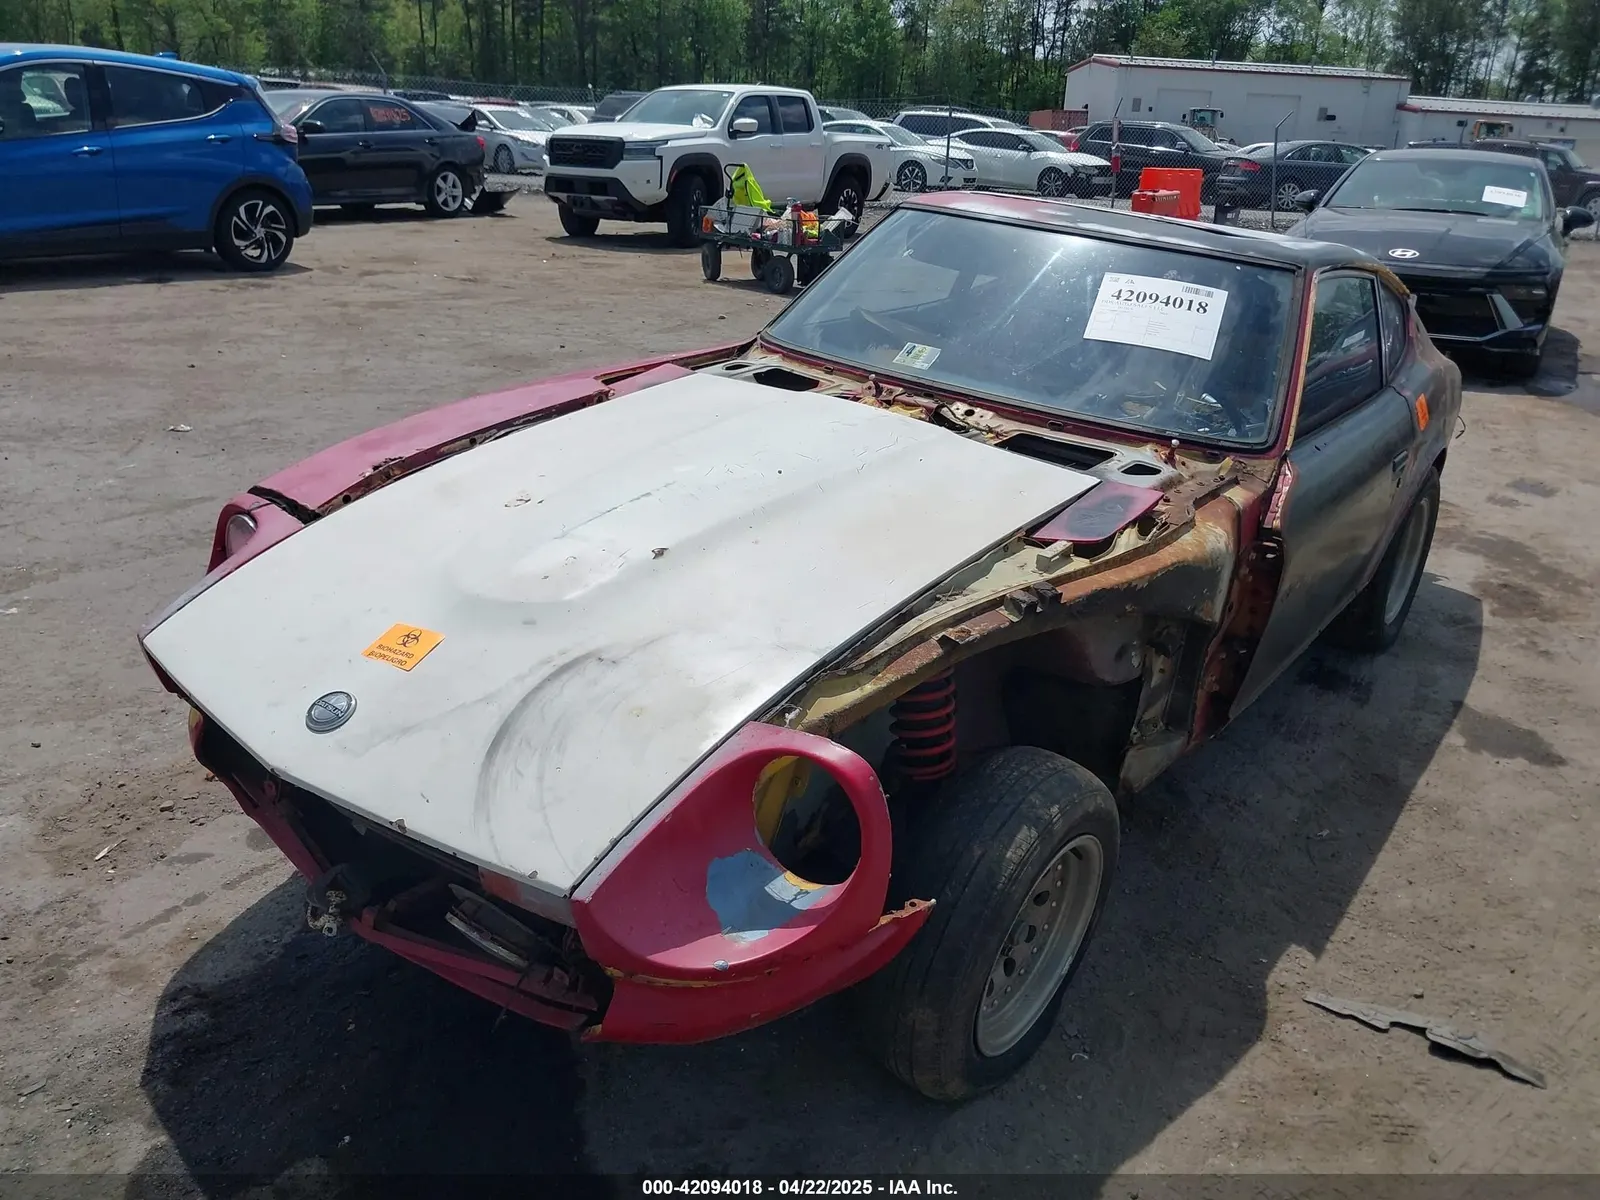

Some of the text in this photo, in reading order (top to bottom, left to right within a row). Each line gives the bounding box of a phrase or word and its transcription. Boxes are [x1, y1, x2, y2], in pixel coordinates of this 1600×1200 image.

[1111, 288, 1209, 314] 42094018
[367, 650, 408, 667] BIOPELIGRO
[376, 643, 415, 659] BIOHAZARD
[315, 699, 345, 718] DATSUN
